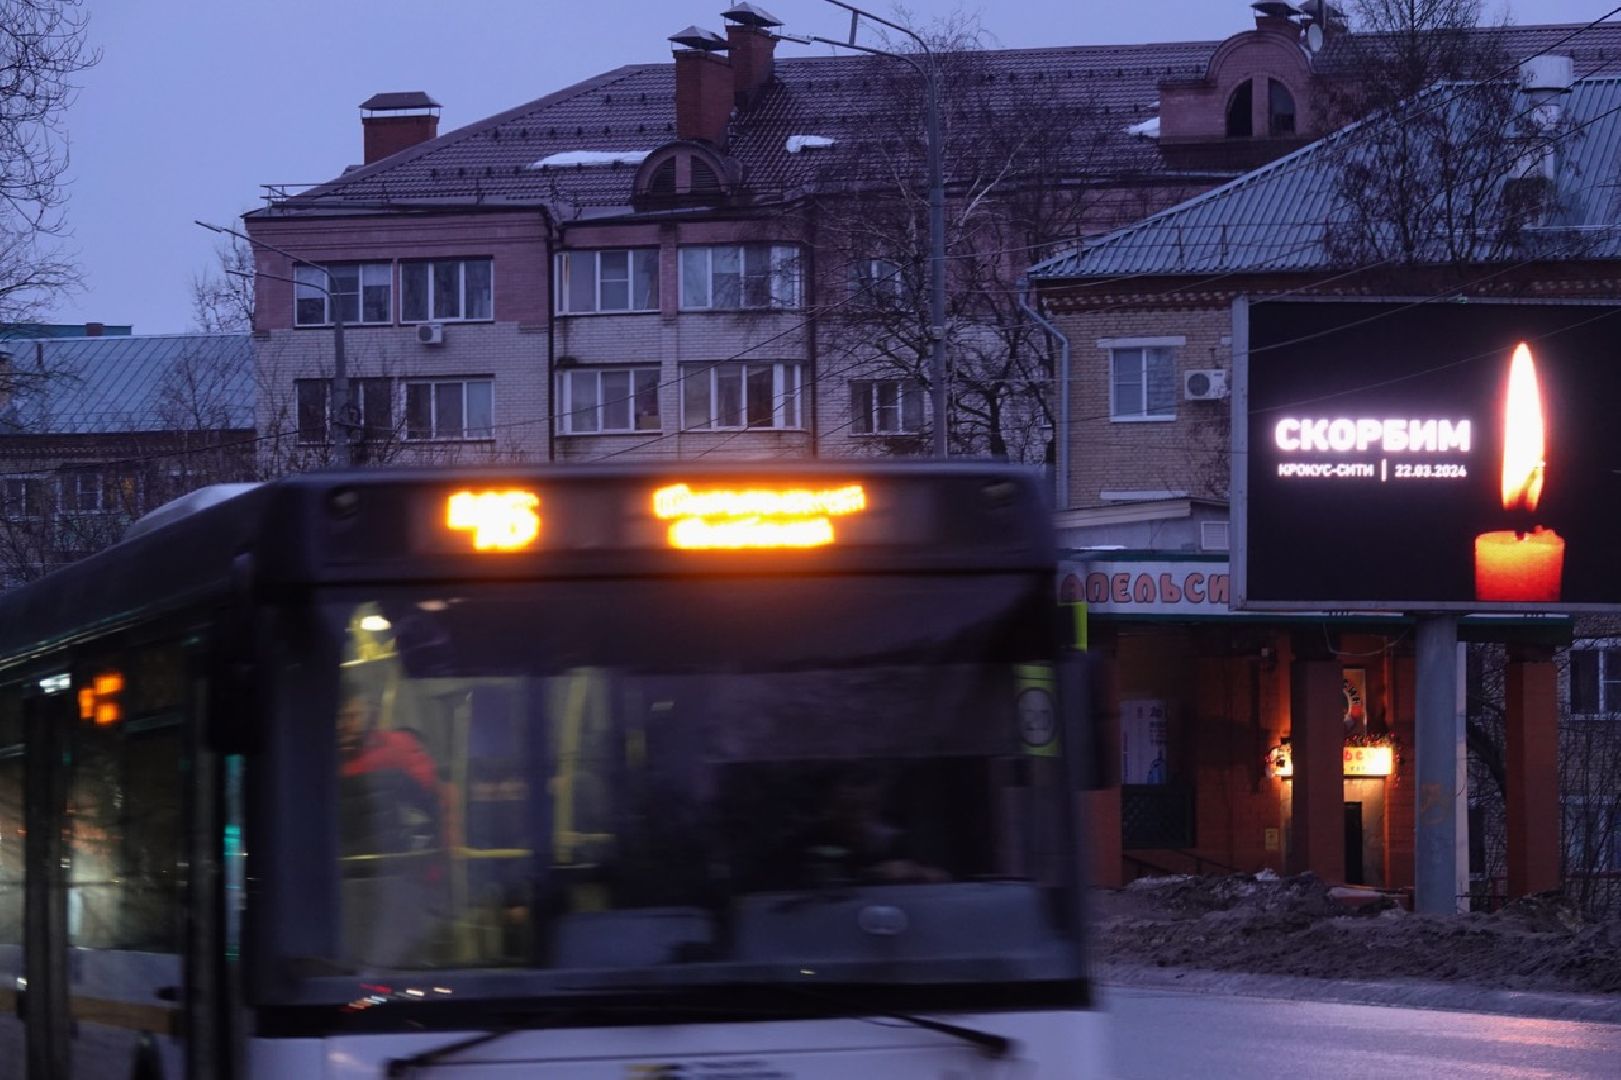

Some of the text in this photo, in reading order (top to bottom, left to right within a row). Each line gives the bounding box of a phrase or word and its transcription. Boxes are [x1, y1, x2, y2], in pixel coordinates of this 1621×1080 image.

[1275, 418, 1471, 452] СКОРБИМ
[1278, 463, 1468, 478] КРОКУС-СИТИ 22.03.2024
